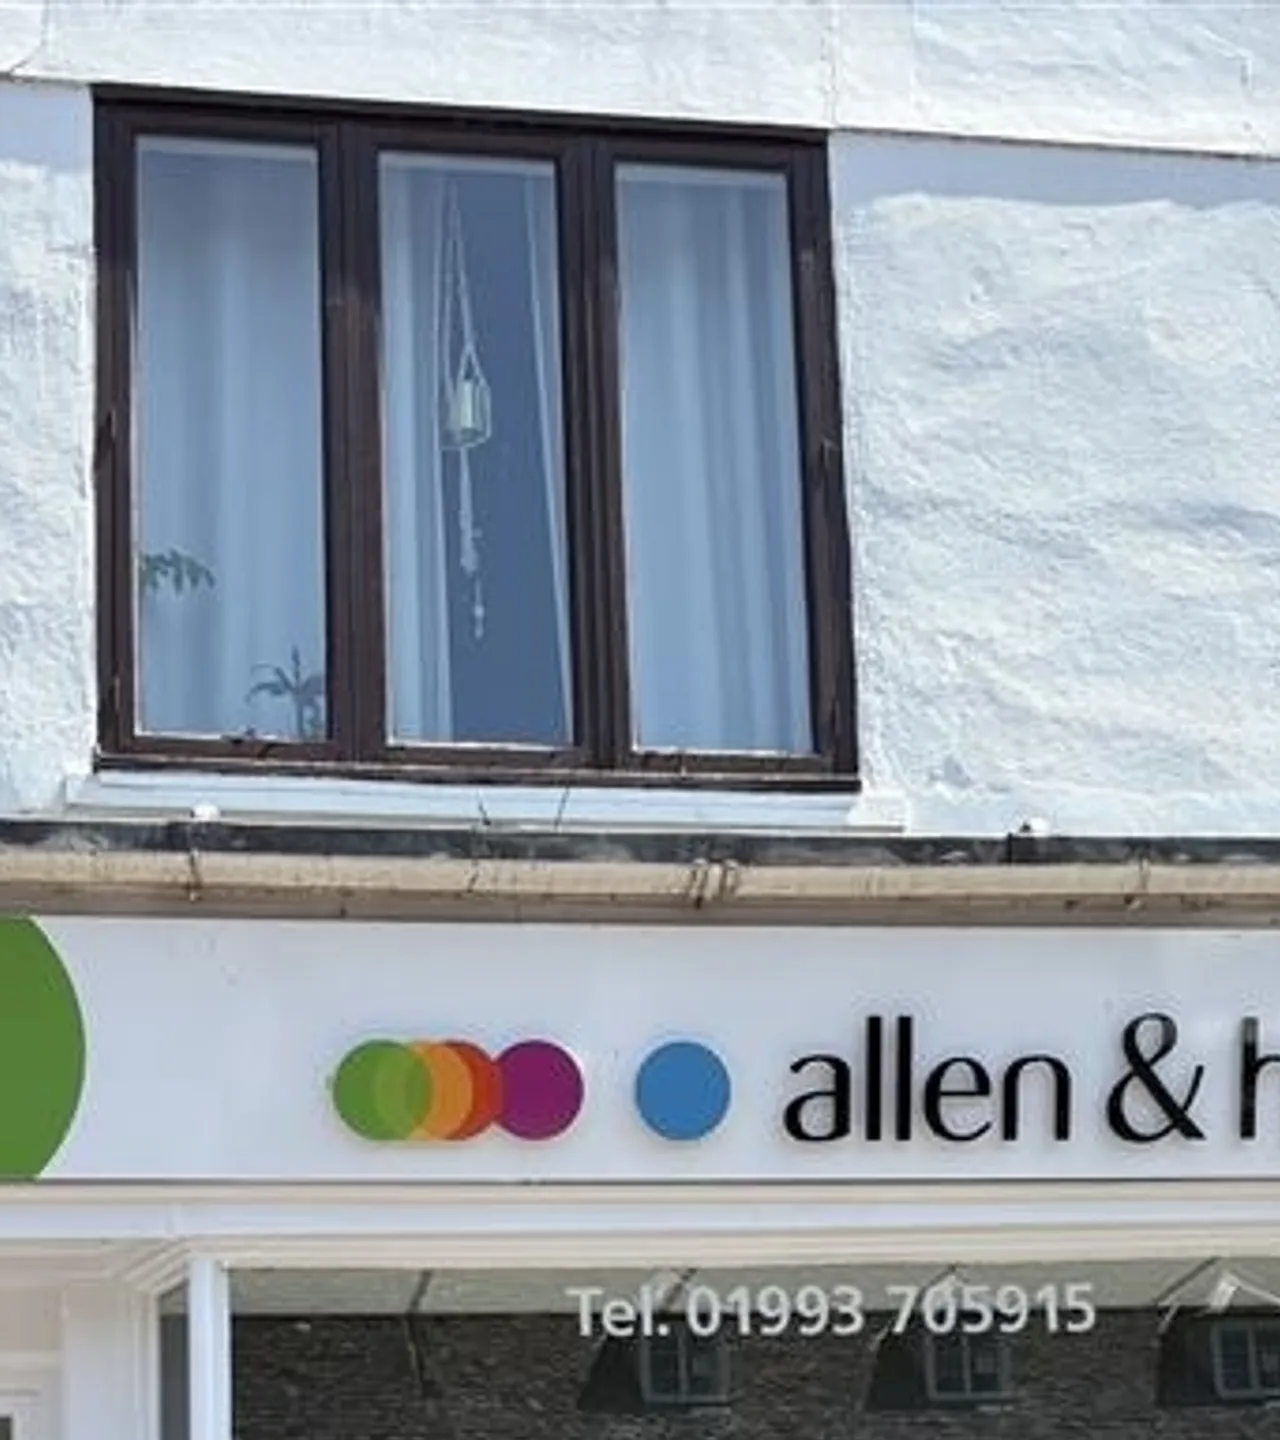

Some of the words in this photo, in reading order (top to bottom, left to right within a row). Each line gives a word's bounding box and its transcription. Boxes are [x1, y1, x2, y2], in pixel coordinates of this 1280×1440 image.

[780, 1014, 1072, 1143] allen
[1106, 1013, 1208, 1143] &
[565, 1287, 668, 1338] Tel.
[685, 1284, 866, 1338] 01993
